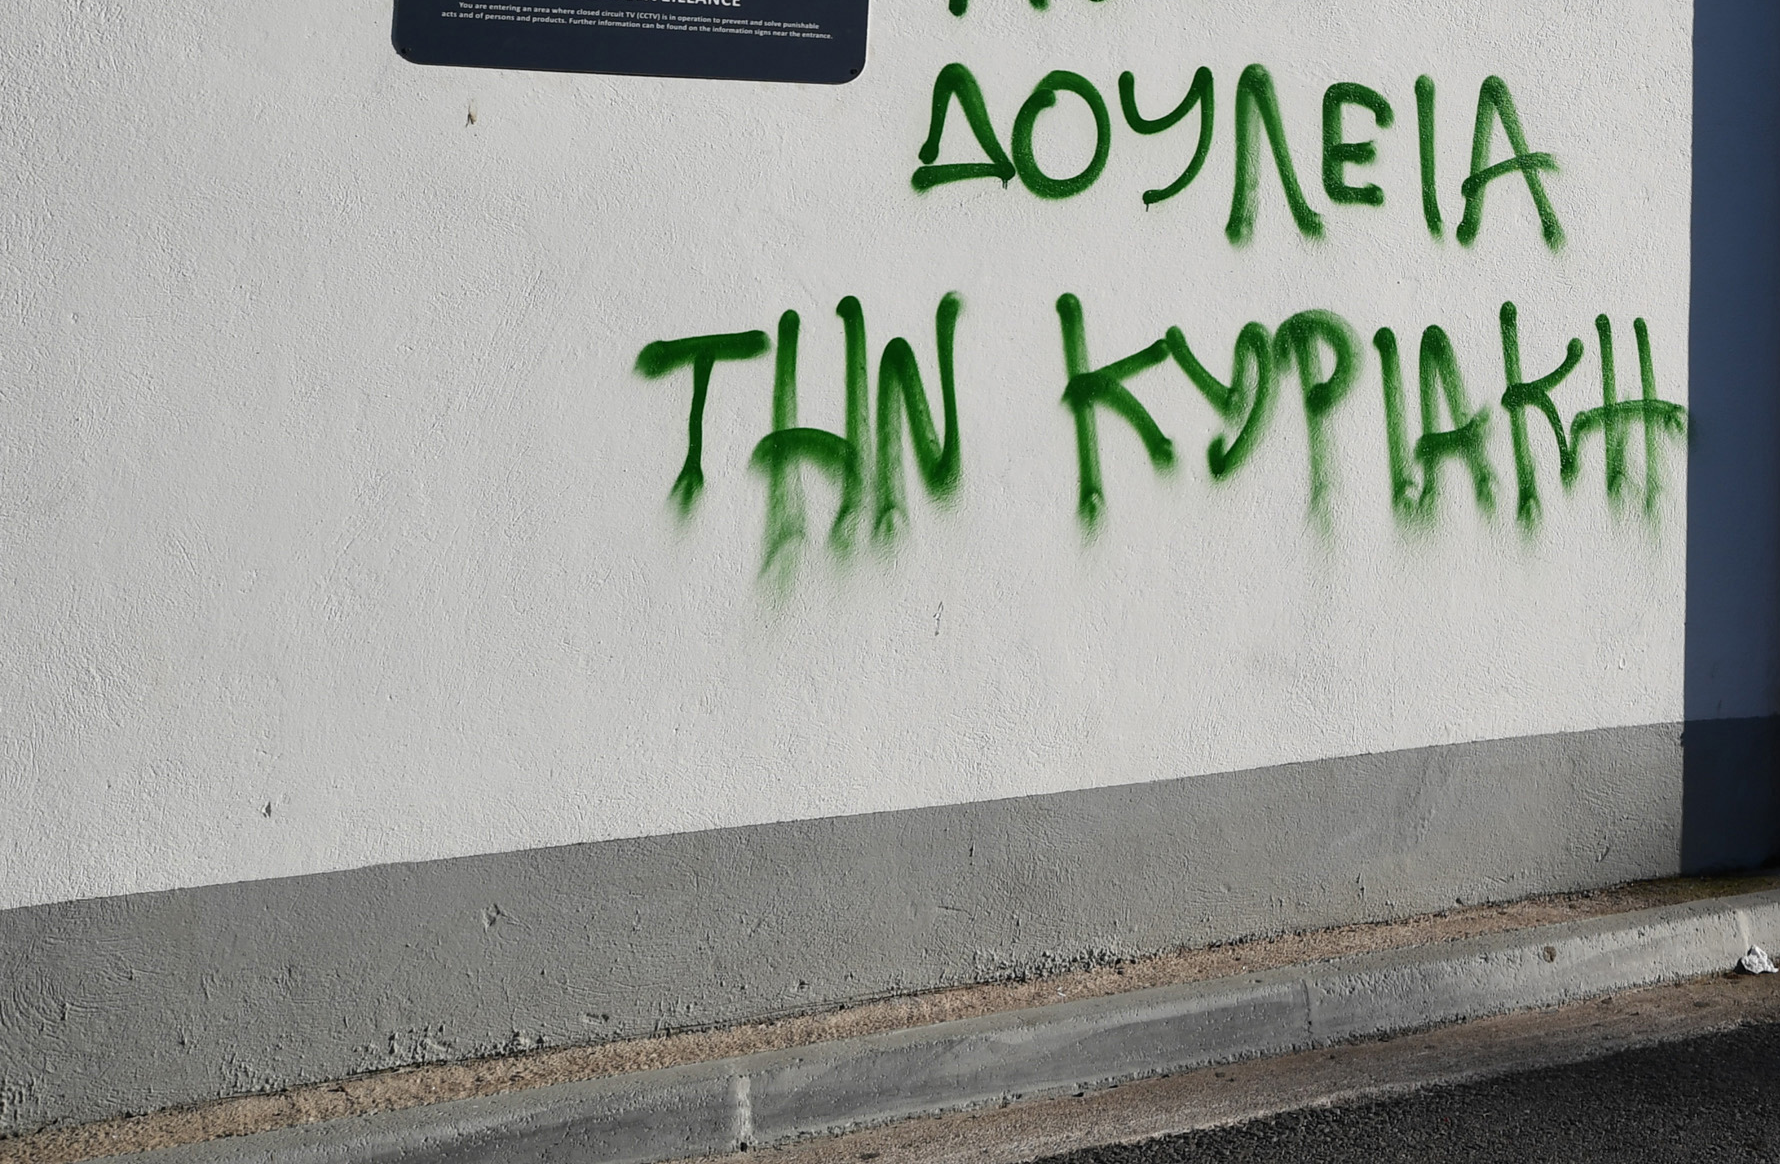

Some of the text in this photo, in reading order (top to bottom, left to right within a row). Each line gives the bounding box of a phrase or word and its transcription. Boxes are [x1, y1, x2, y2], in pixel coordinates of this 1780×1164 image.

[488, 4, 521, 13] entering
[551, 7, 575, 15] where
[576, 8, 601, 17] closed
[601, 10, 625, 18] circuit
[636, 11, 661, 21] (CCTV)
[677, 15, 712, 23] operation
[721, 18, 749, 26] prevent
[763, 20, 782, 28] solve
[782, 21, 820, 30] punishable
[531, 16, 568, 24] products.
[568, 17, 597, 26] Further
[597, 19, 641, 28] information
[666, 23, 688, 31] found
[711, 25, 754, 35] information
[754, 28, 772, 37] signs
[911, 63, 1564, 250] ΔΟΥΛΕΙΑ
[635, 292, 1687, 571] ΤΗΝ ΚΥΡΙΑΚΗ
